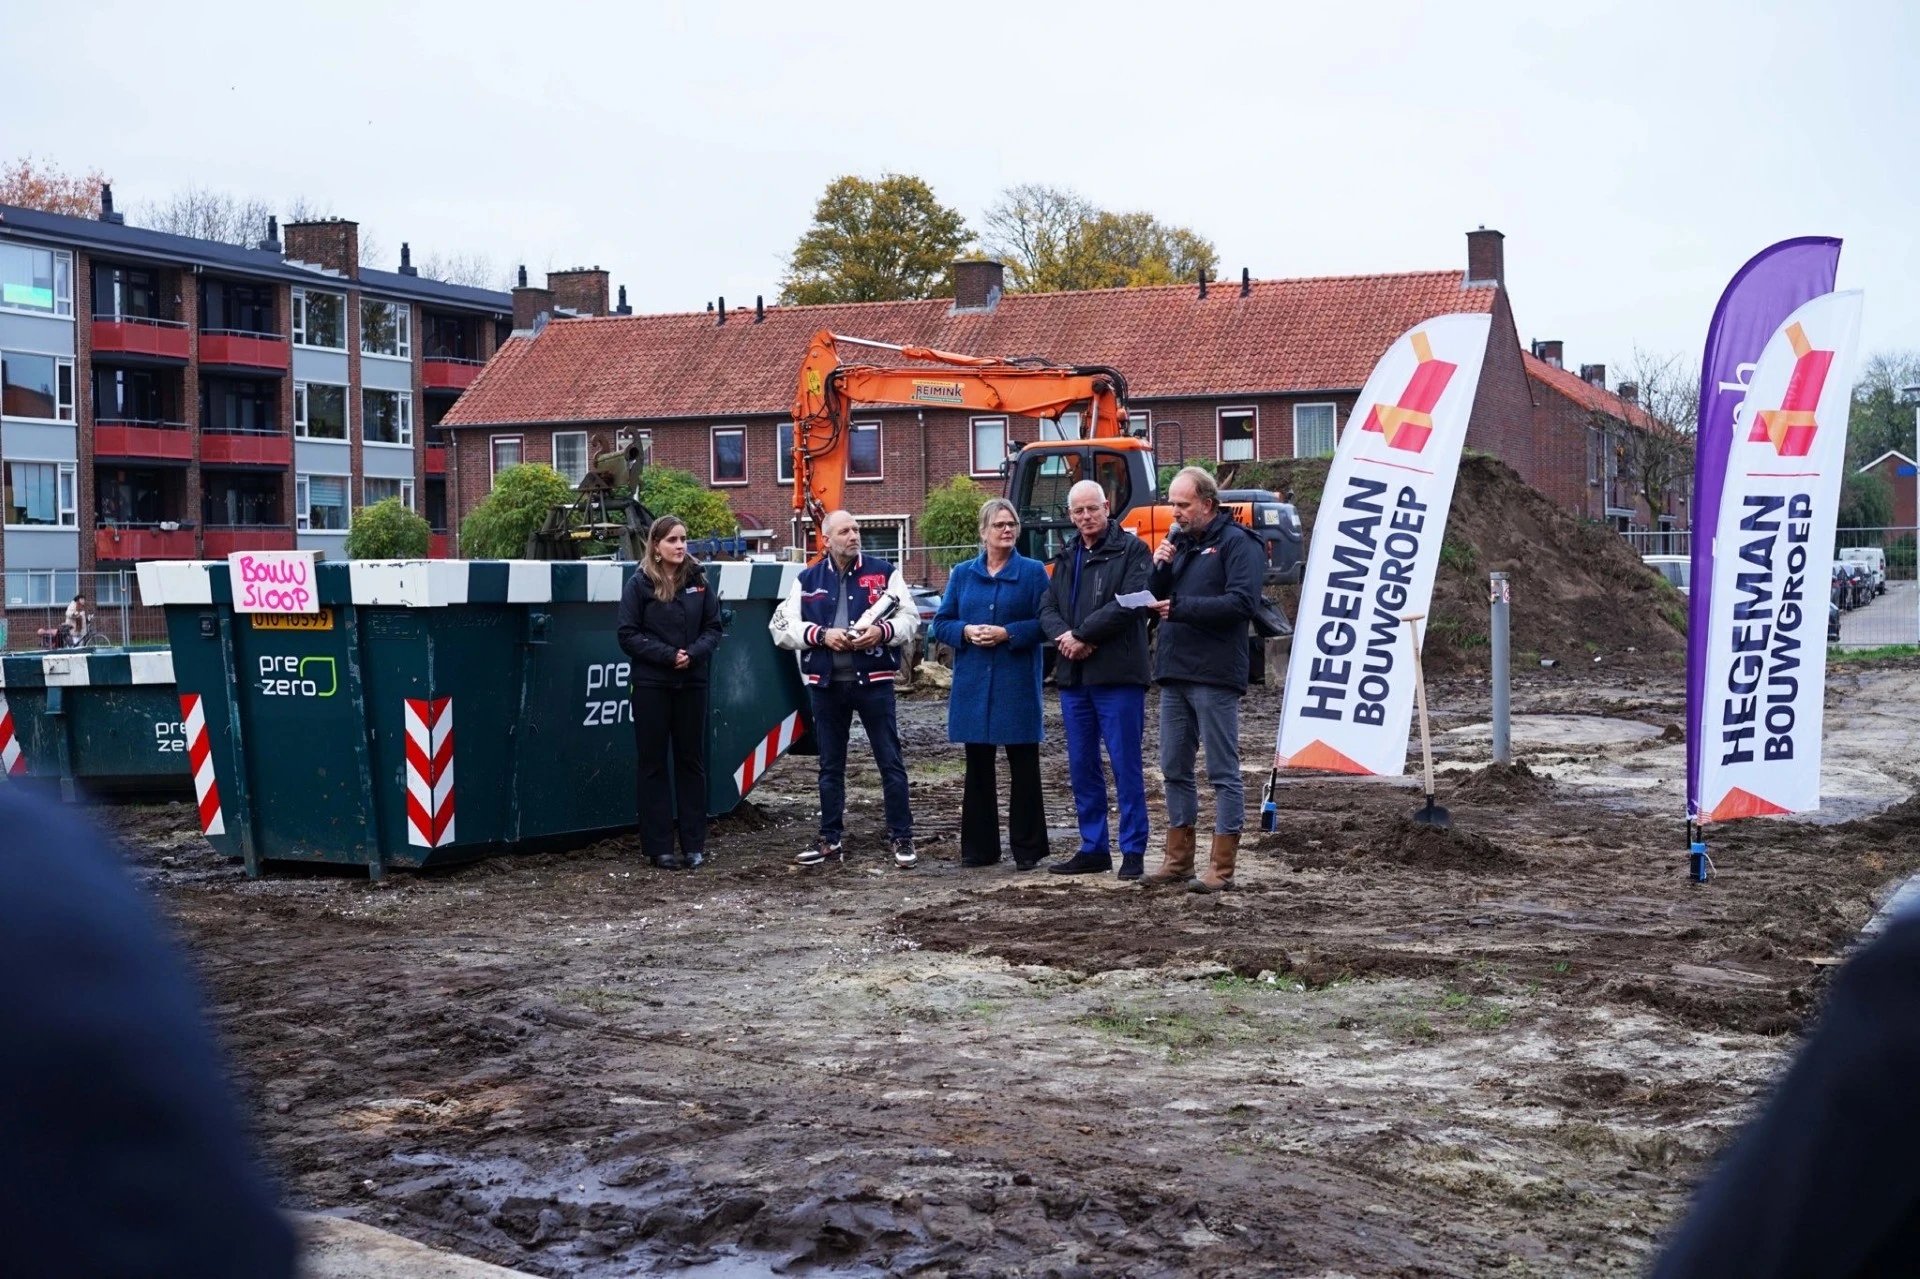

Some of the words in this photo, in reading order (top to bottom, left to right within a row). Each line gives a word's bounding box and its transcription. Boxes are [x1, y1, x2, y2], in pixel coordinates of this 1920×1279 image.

[259, 655, 299, 677] pre
[1299, 477, 1388, 721] HEGEMAN
[1352, 485, 1428, 727] BOUWGROEP
[1720, 495, 1785, 766] HEGEMAN
[1763, 493, 1813, 761] BOUWGROEP
[157, 739, 188, 752] ze
[261, 679, 317, 697] zero
[586, 662, 632, 697] pre
